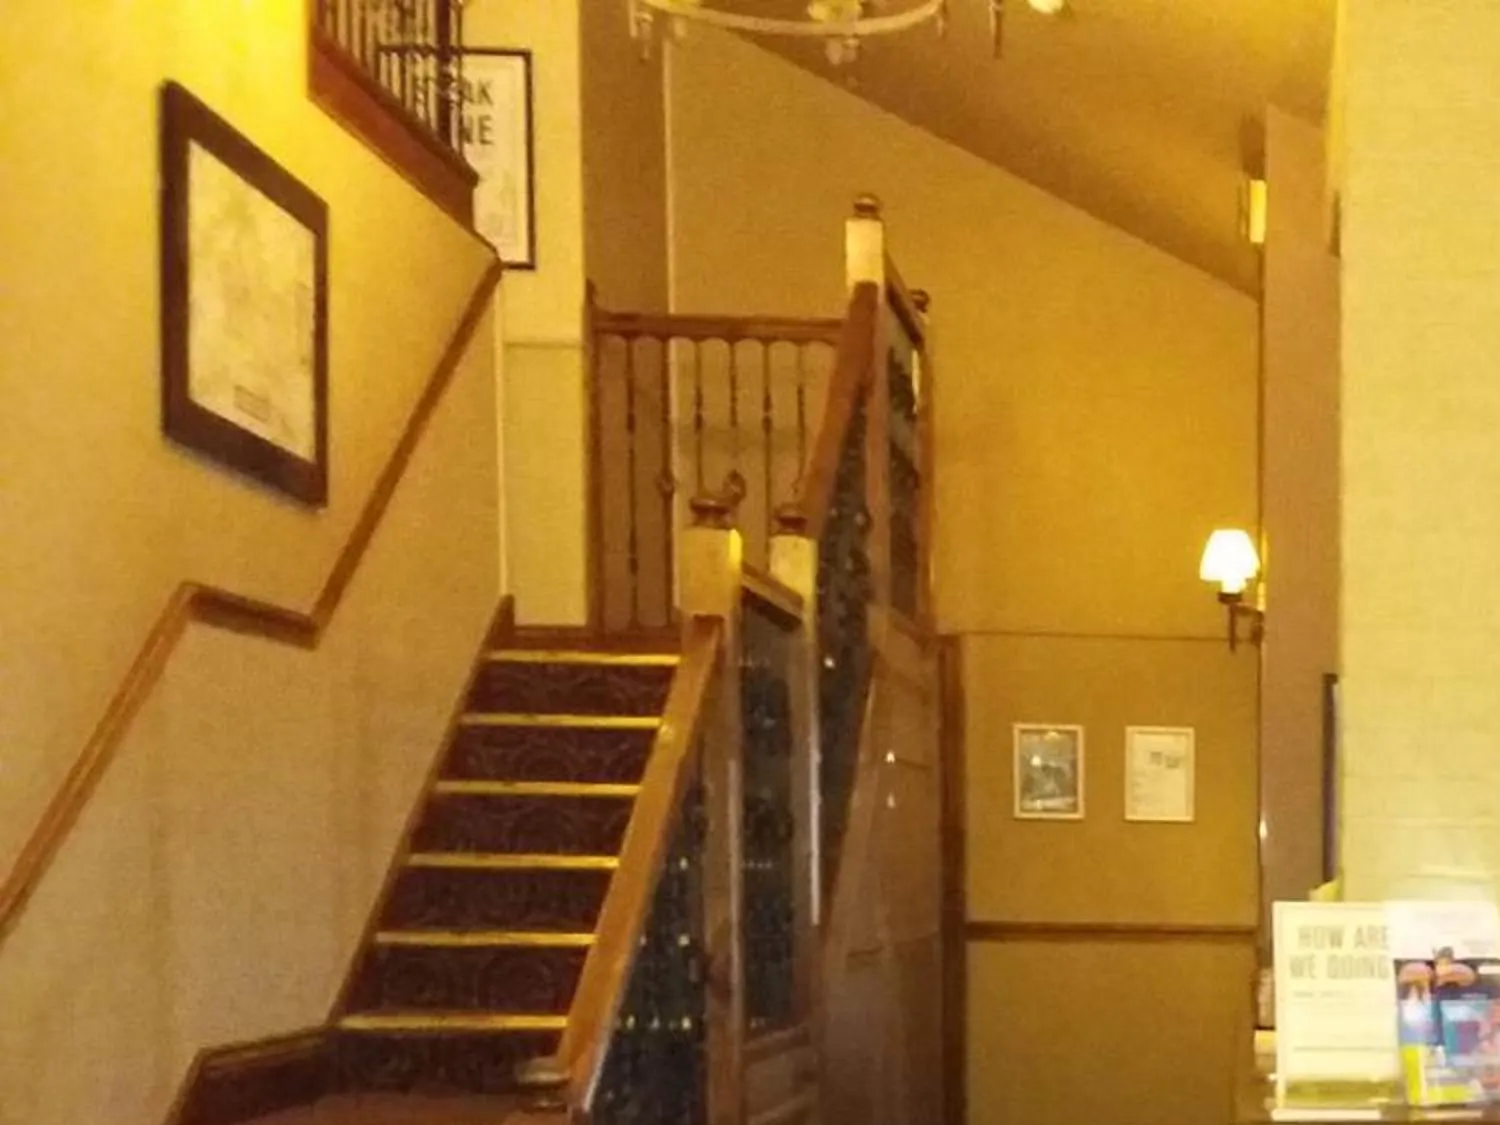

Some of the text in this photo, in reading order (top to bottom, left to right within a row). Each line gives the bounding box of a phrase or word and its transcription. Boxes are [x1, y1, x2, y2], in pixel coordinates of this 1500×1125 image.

[1298, 924, 1389, 950] HOW ARE
[1290, 953, 1389, 981] WE DOING
